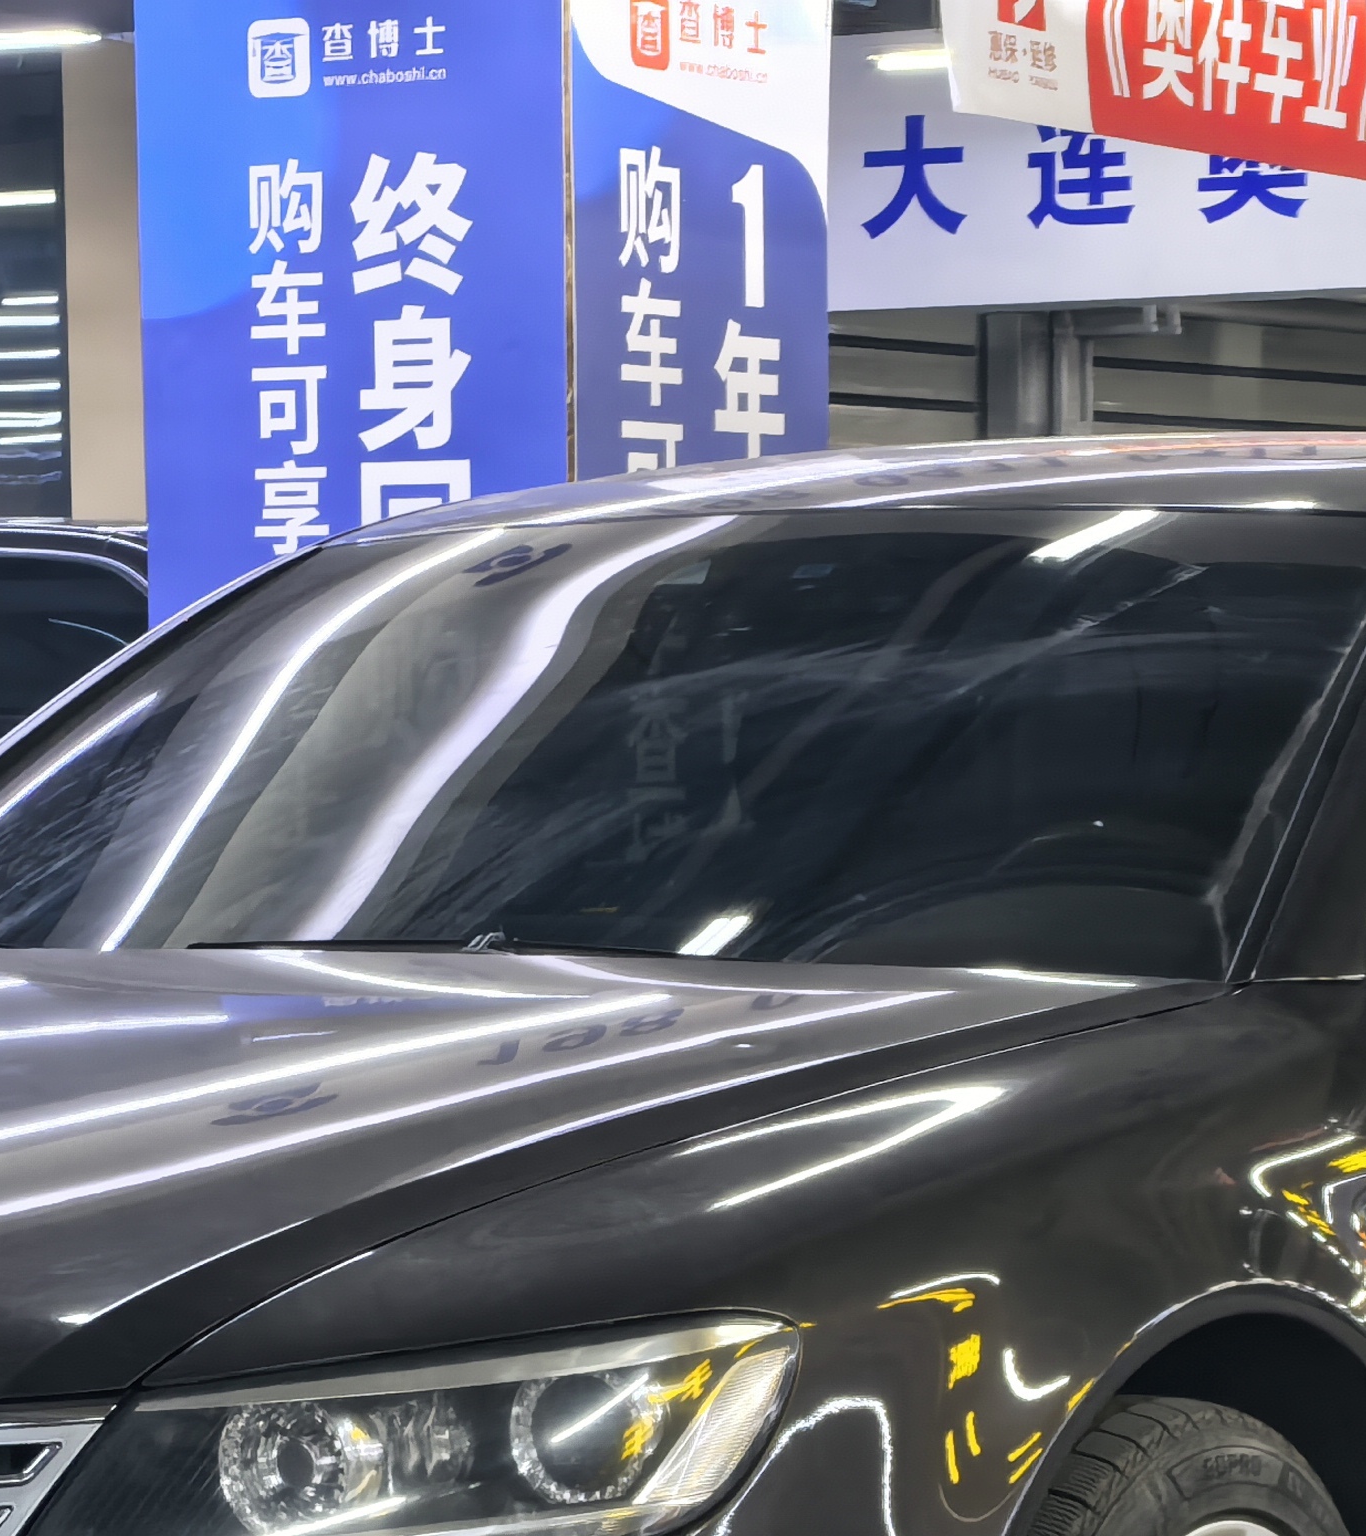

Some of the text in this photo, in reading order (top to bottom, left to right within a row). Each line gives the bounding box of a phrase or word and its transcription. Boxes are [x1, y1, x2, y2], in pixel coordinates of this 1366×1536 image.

[322, 16, 446, 62] 查博士
[679, 0, 767, 54] 查博士
[323, 66, 447, 87] www.chaboshi.cn
[713, 163, 785, 460] 1年
[247, 158, 329, 556] 购车可享
